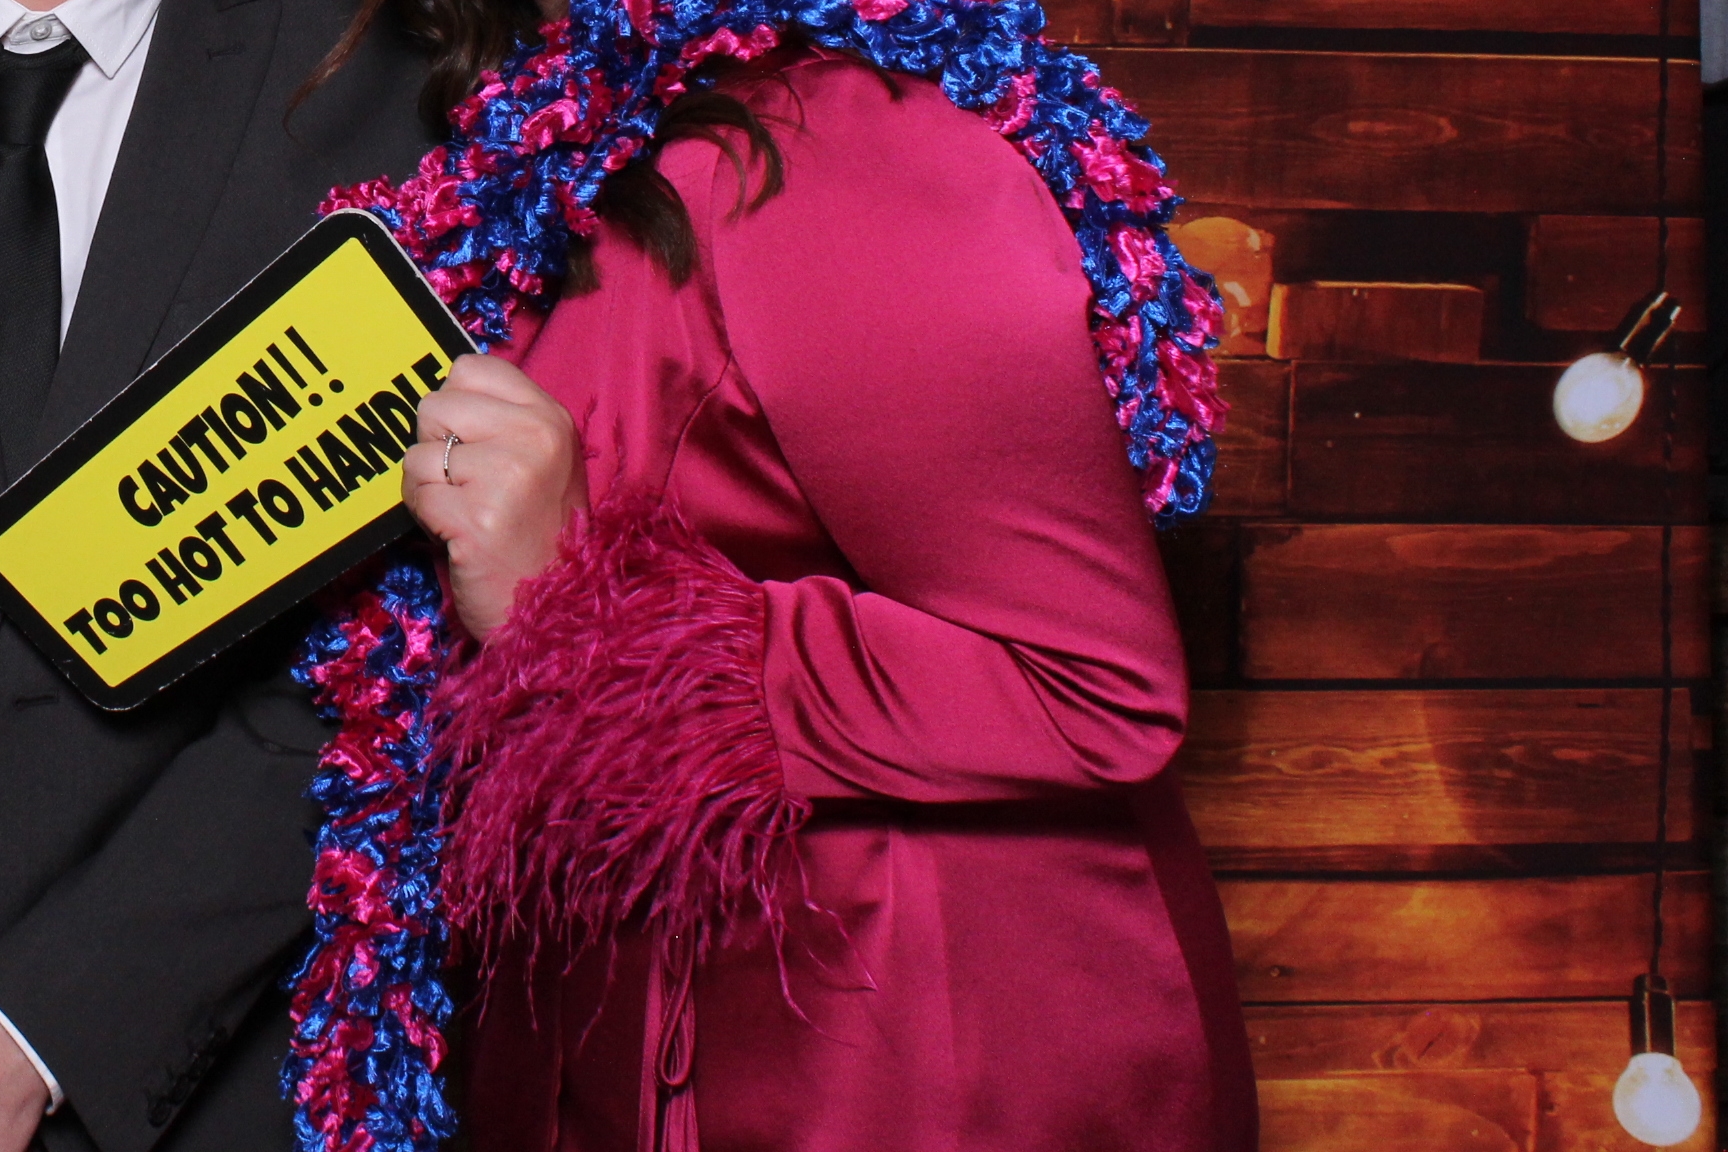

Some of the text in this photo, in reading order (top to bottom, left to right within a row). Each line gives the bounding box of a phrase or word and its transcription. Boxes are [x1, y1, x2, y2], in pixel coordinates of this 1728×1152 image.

[118, 325, 345, 528] CAUTION!!
[63, 579, 161, 655] TOO
[145, 511, 246, 606] HOT
[227, 478, 305, 545] TO
